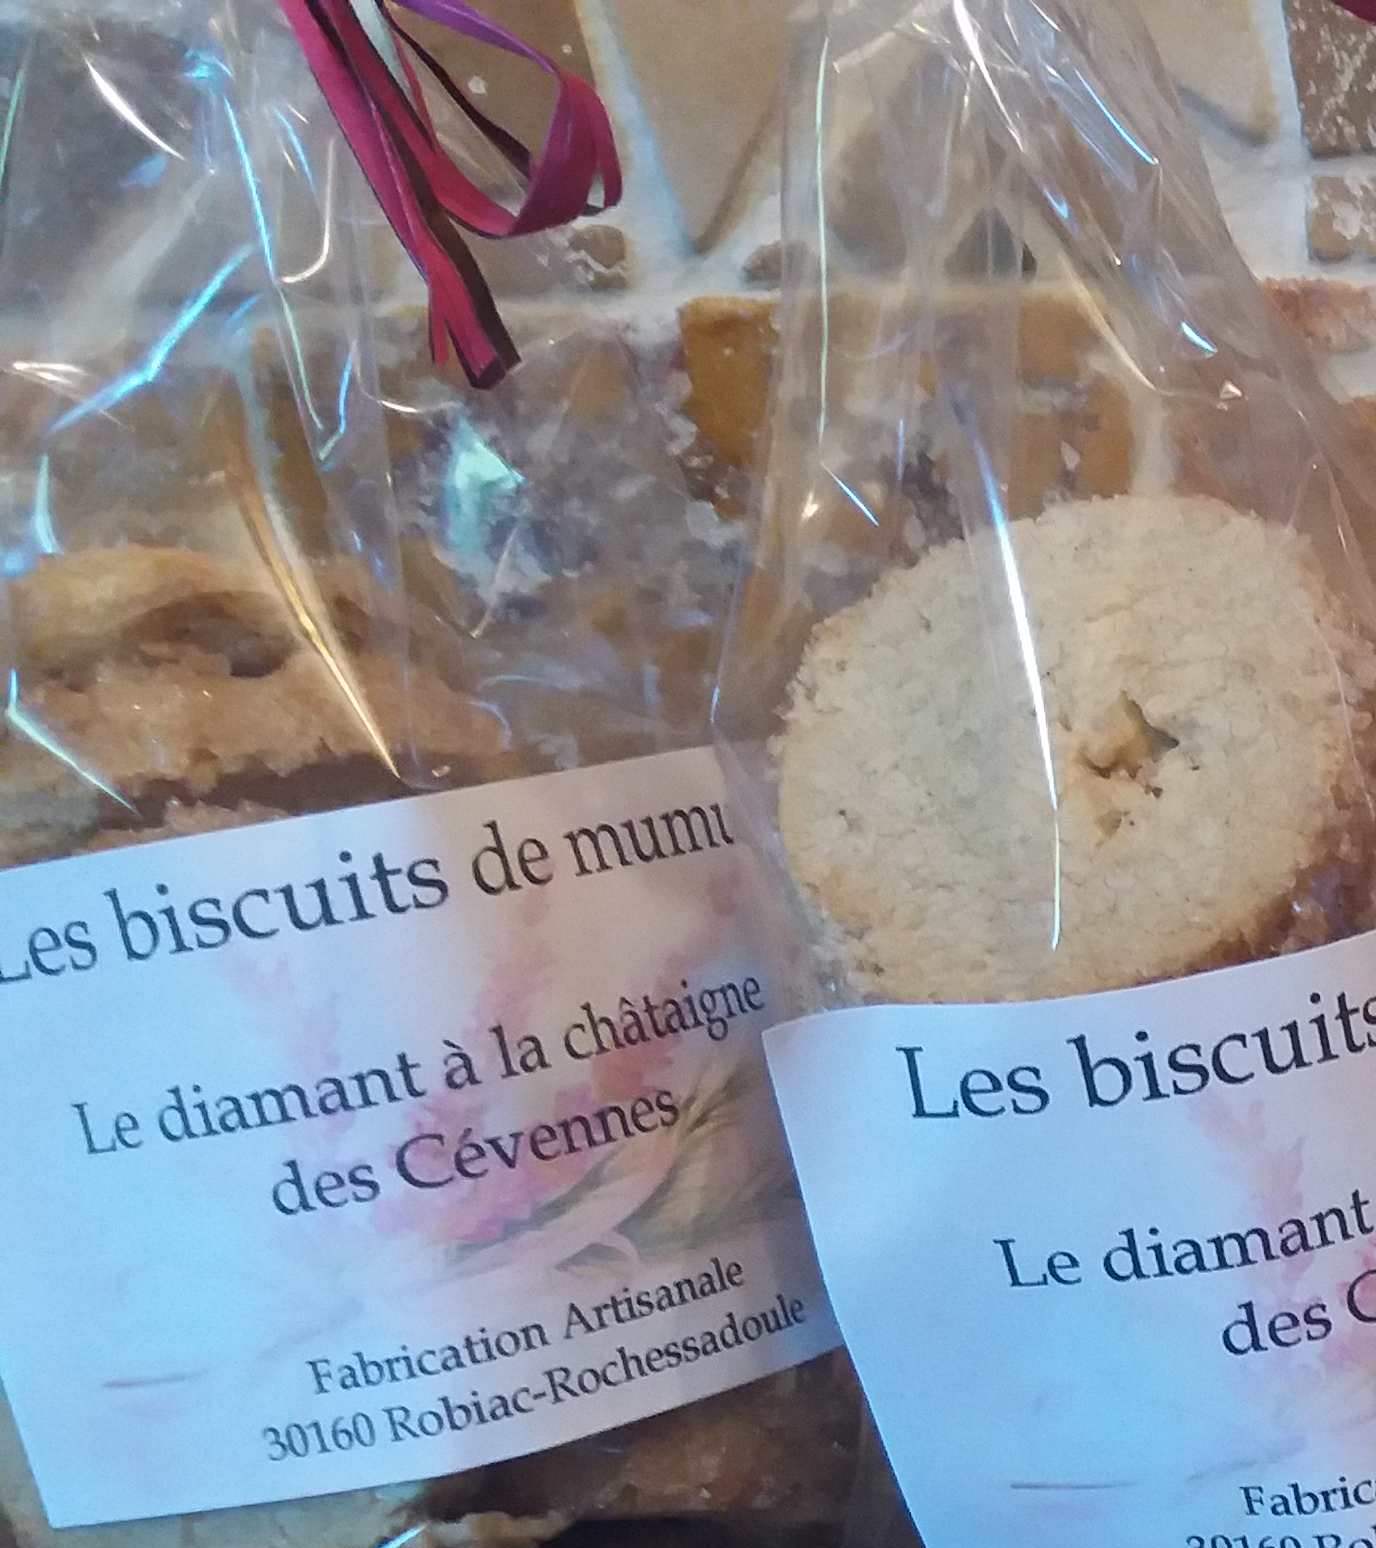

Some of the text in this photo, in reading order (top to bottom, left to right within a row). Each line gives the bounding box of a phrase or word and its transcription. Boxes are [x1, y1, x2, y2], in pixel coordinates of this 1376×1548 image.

[103, 849, 451, 962] biscuits
[470, 821, 554, 897] de
[71, 971, 769, 1156] Le diamant à la châtaigne
[895, 1045, 1051, 1120] Les
[272, 1088, 681, 1217] des Cévennes
[994, 1236, 1081, 1288] Le
[1103, 1188, 1371, 1284] diamant
[263, 1296, 808, 1462] 30160 Robiac-Rochessadoule
[308, 1257, 745, 1395] Fabrication Artisanale
[1221, 1302, 1333, 1357] des
